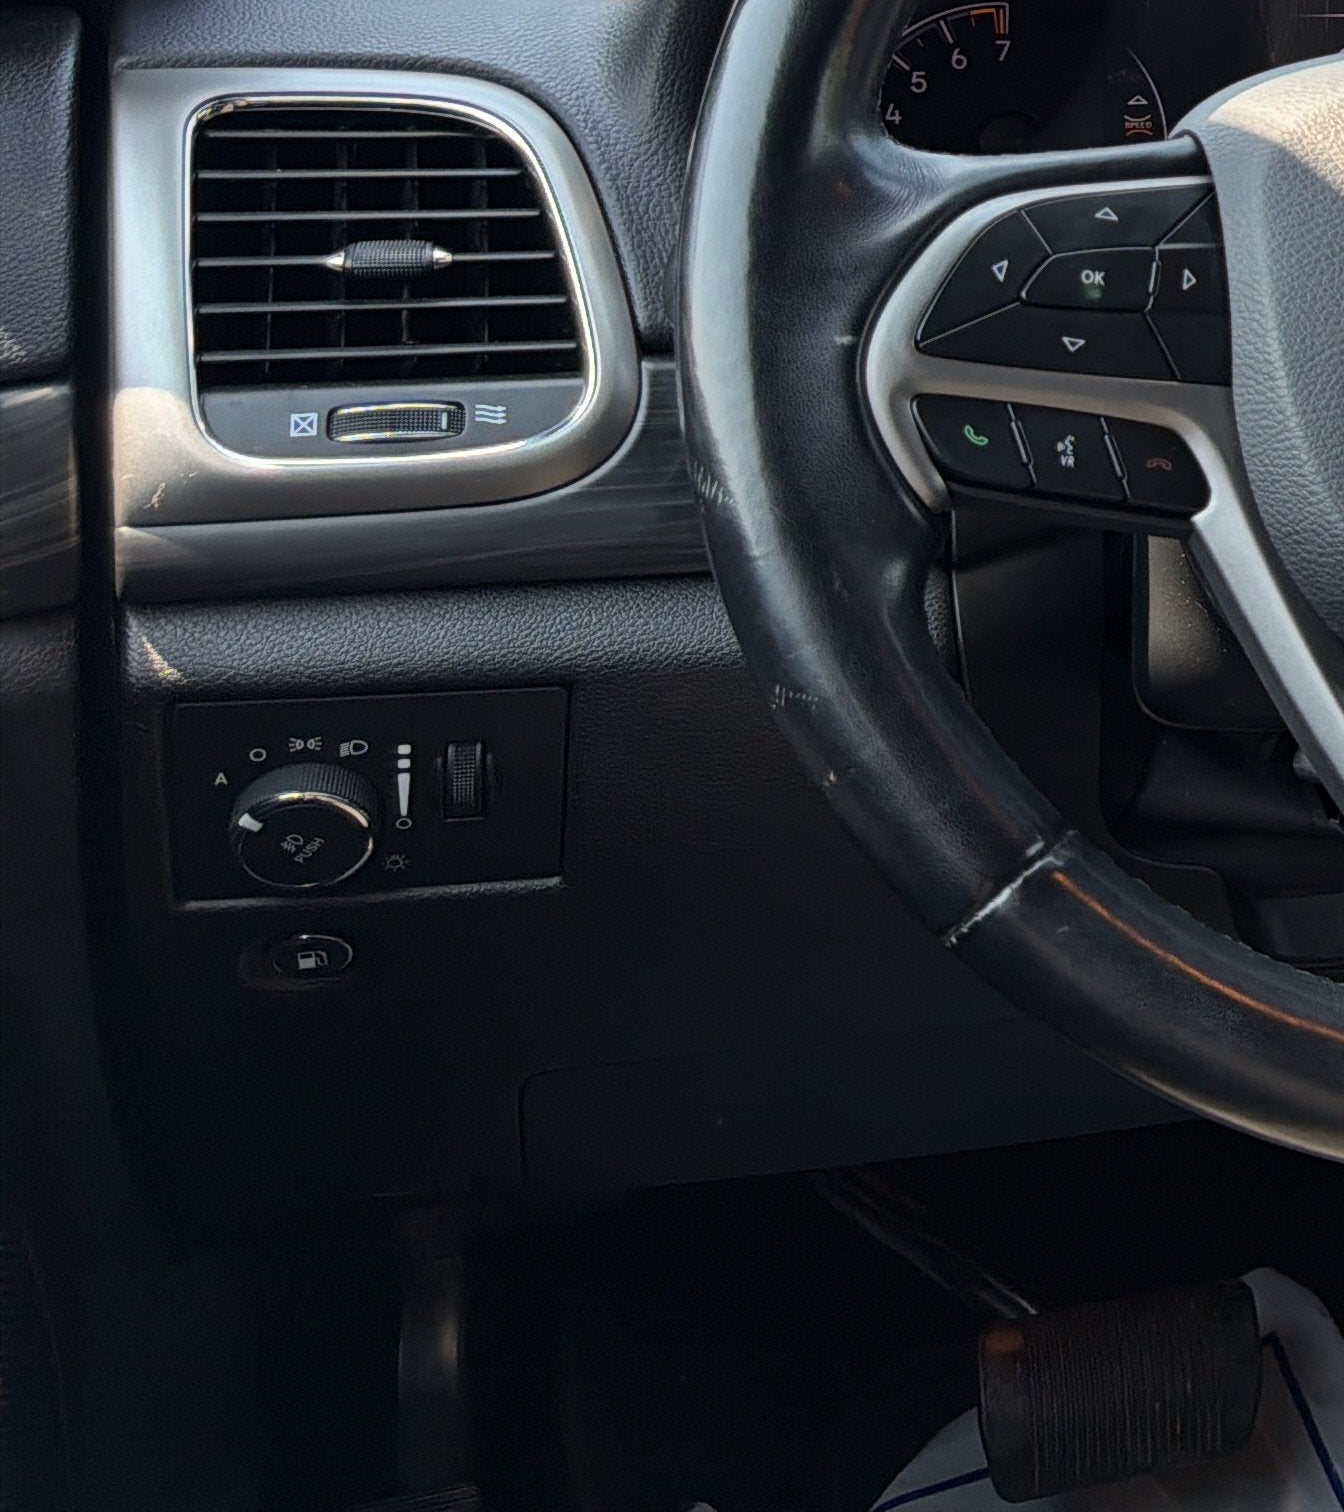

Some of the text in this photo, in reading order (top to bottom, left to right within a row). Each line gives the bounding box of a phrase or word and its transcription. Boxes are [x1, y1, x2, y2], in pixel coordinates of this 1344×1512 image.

[951, 48, 968, 70] 6
[995, 40, 1011, 62] 7
[910, 71, 927, 93] 5
[885, 103, 902, 125] 4
[1081, 269, 1106, 286] OK
[1059, 455, 1075, 468] VR
[214, 772, 228, 786] A
[293, 836, 325, 864] PUSH
